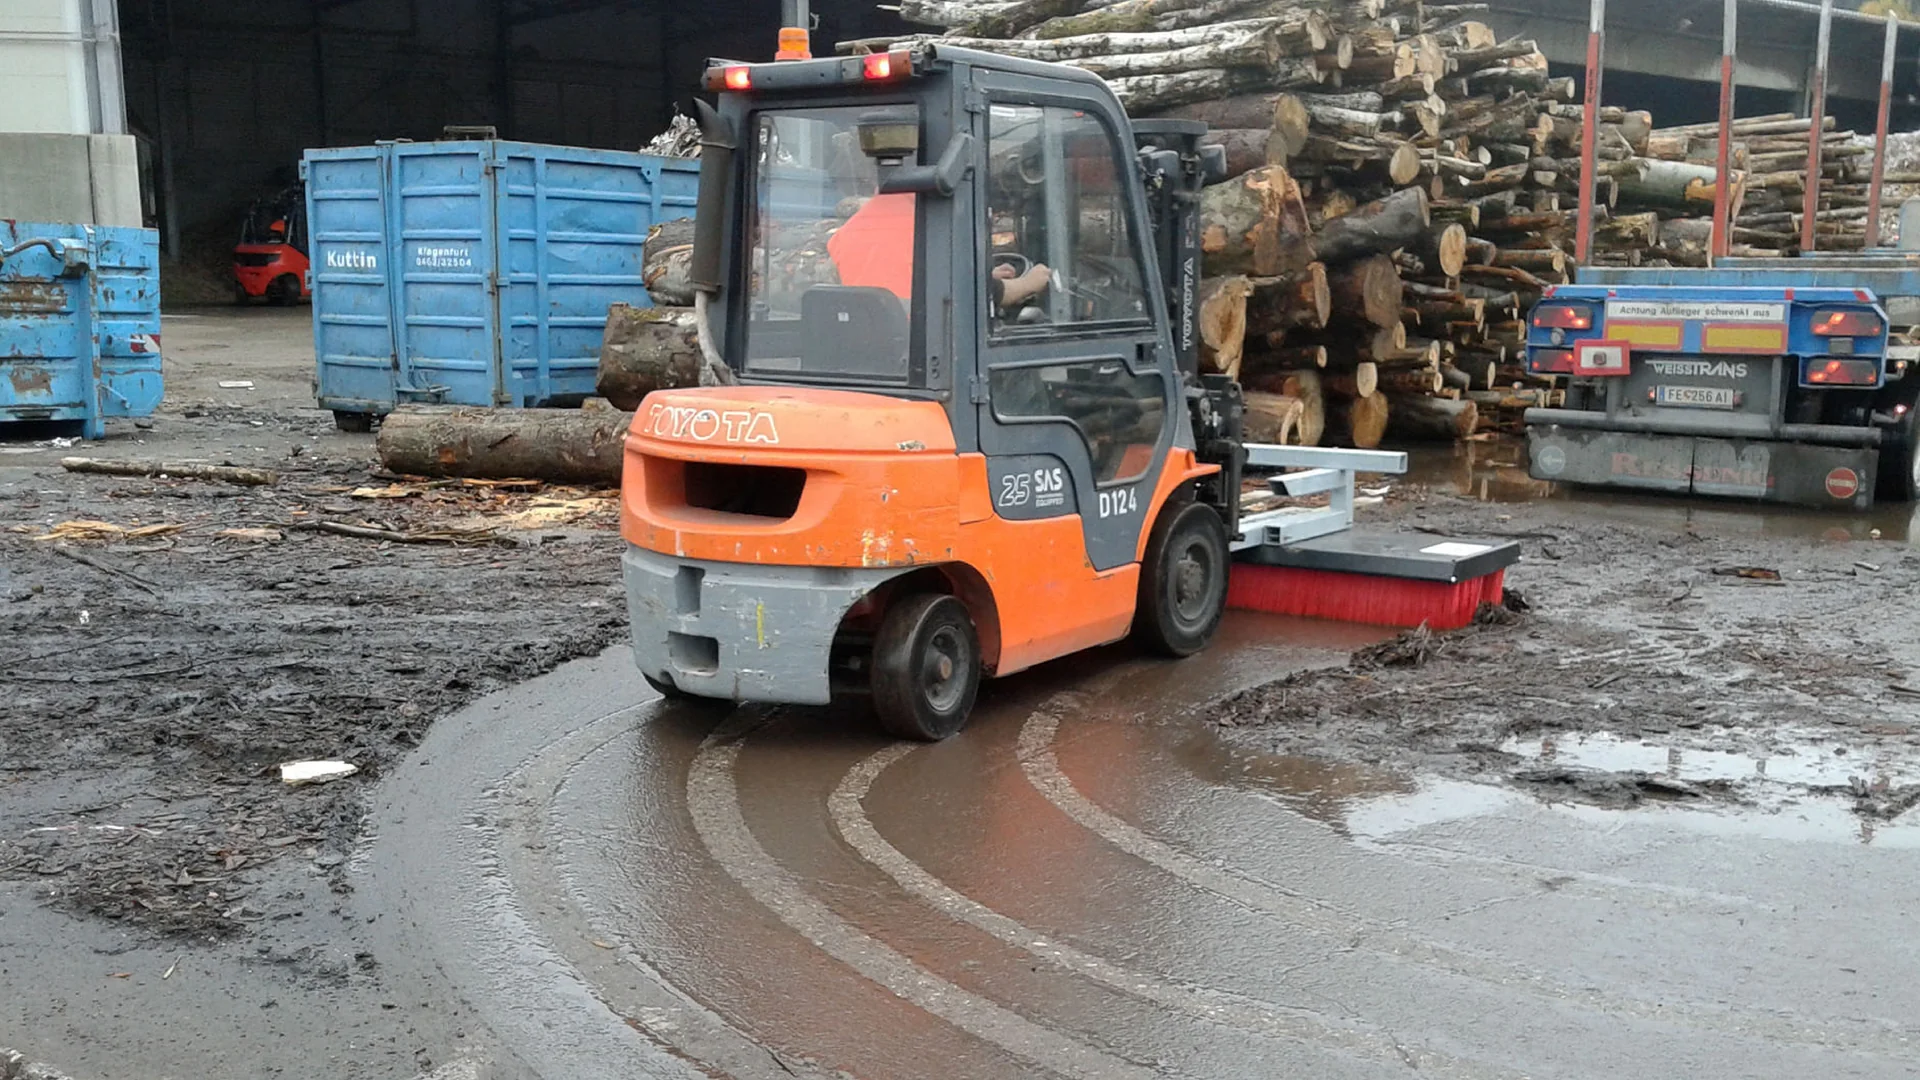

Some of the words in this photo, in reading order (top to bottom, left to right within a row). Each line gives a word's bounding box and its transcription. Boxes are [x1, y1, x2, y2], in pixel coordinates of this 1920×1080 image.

[327, 250, 377, 268] Kuttin
[1182, 257, 1194, 351] TOYOTA
[1619, 306, 1656, 316] Achtung
[1705, 306, 1749, 317] schwenkt
[1753, 308, 1770, 318] aus
[1645, 360, 1748, 379] WEISSTRANS
[644, 403, 780, 444] TOYOTA
[998, 473, 1031, 507] 25
[1034, 468, 1063, 493] SAS
[1099, 487, 1137, 518] D124
